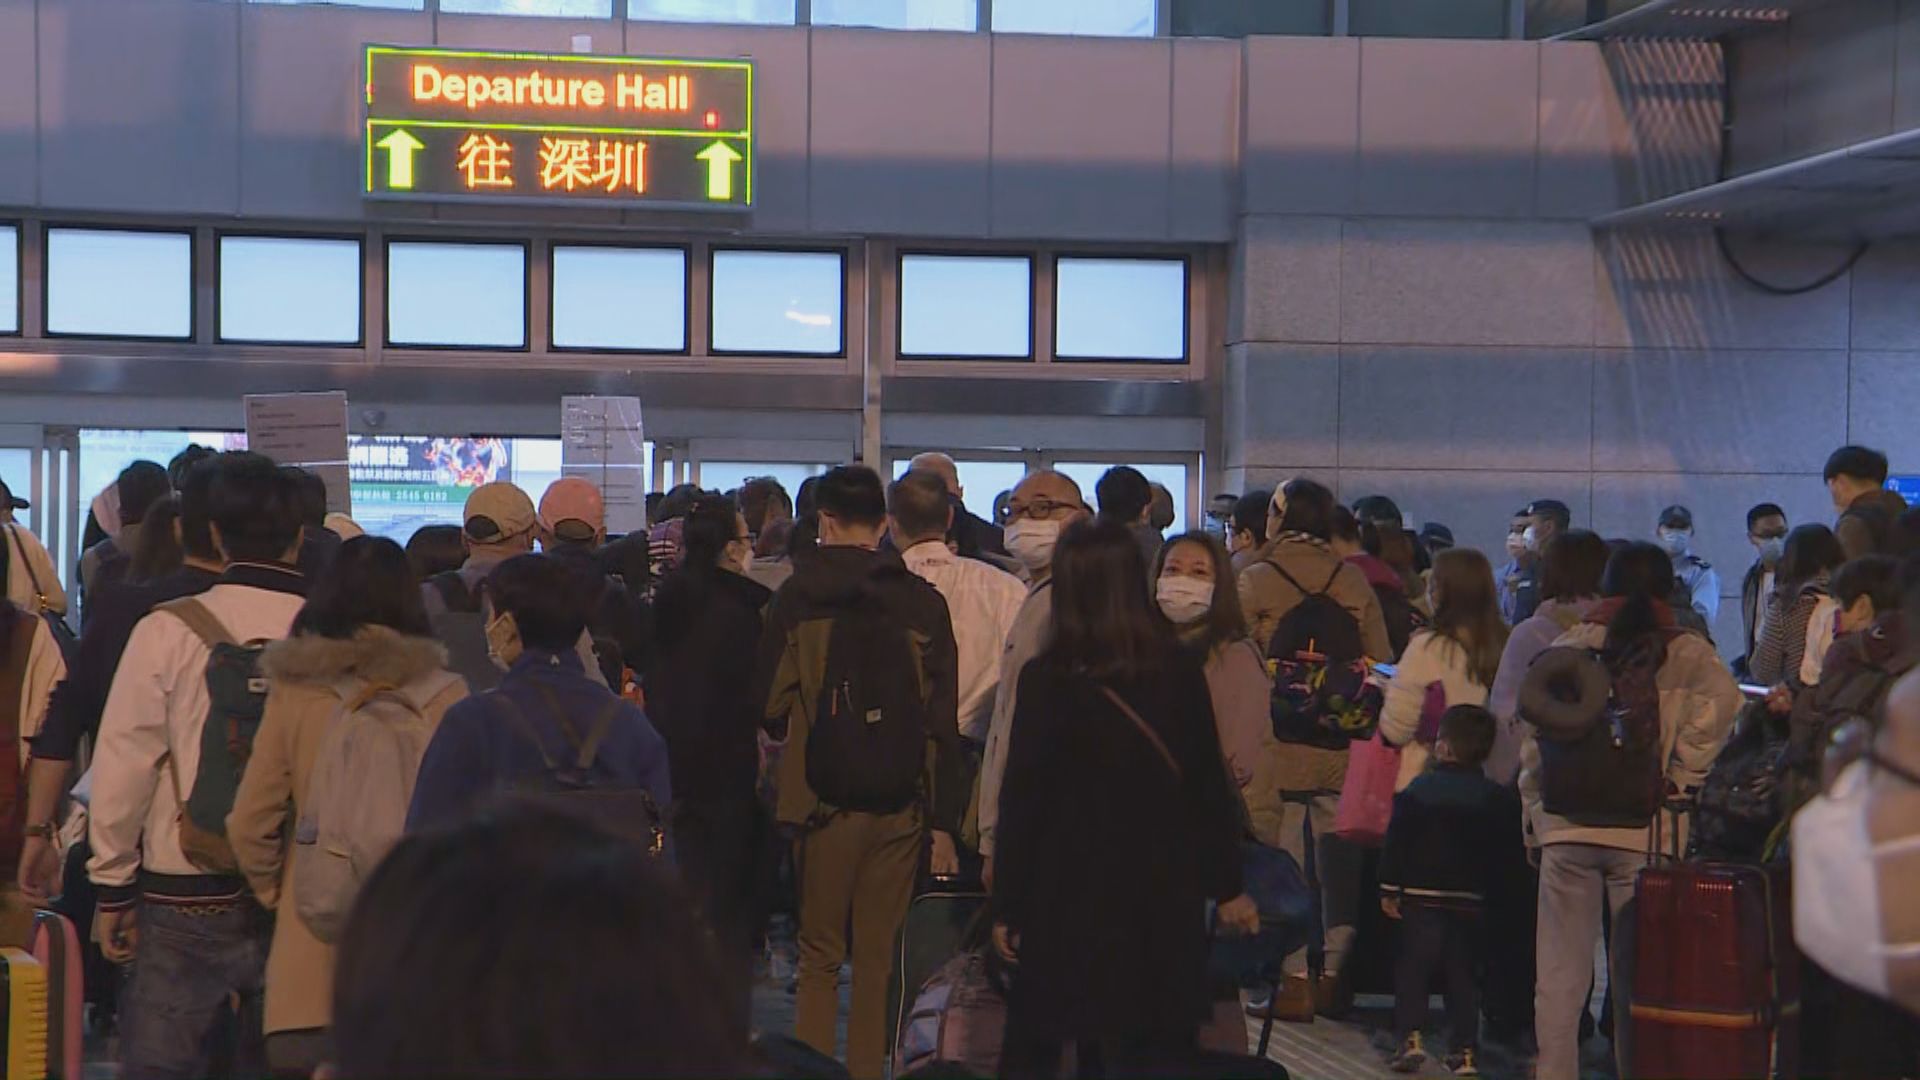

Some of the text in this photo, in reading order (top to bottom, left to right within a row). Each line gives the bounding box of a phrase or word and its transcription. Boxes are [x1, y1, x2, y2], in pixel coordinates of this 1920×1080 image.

[412, 65, 689, 110] Departure Hall
[458, 133, 647, 194] 往 深圳
